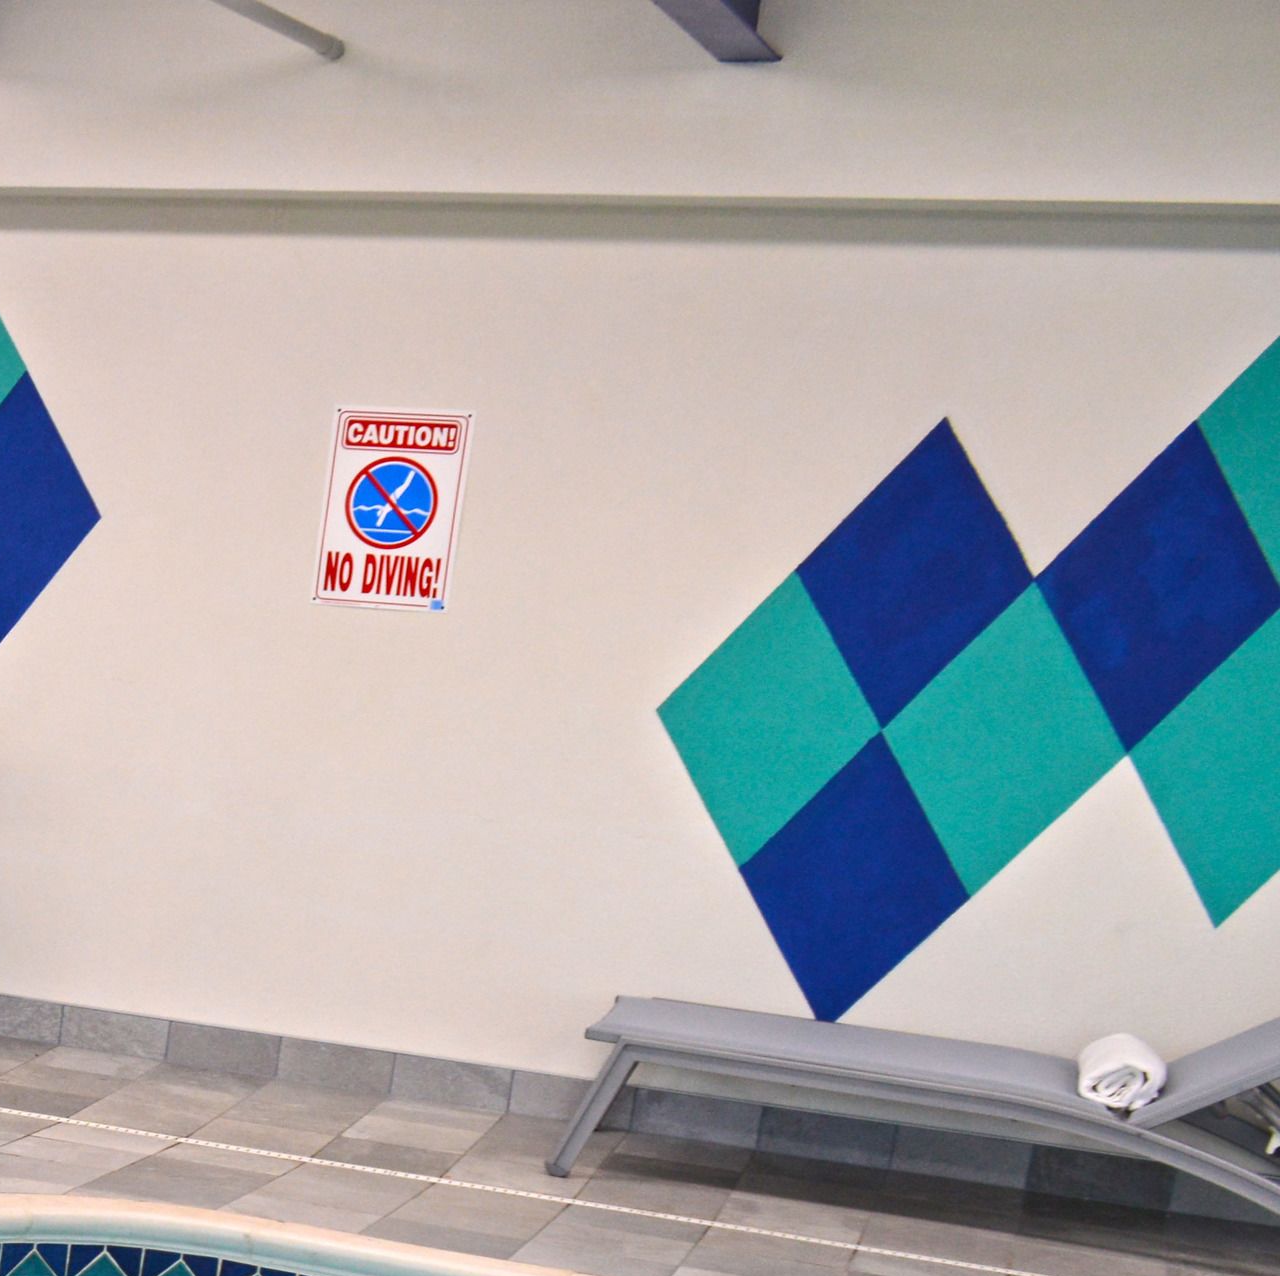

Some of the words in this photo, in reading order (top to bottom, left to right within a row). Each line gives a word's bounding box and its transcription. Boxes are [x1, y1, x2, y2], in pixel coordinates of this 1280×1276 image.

[347, 423, 457, 447] CAUTION!
[323, 551, 354, 592] NO
[361, 554, 442, 599] DIVING!
